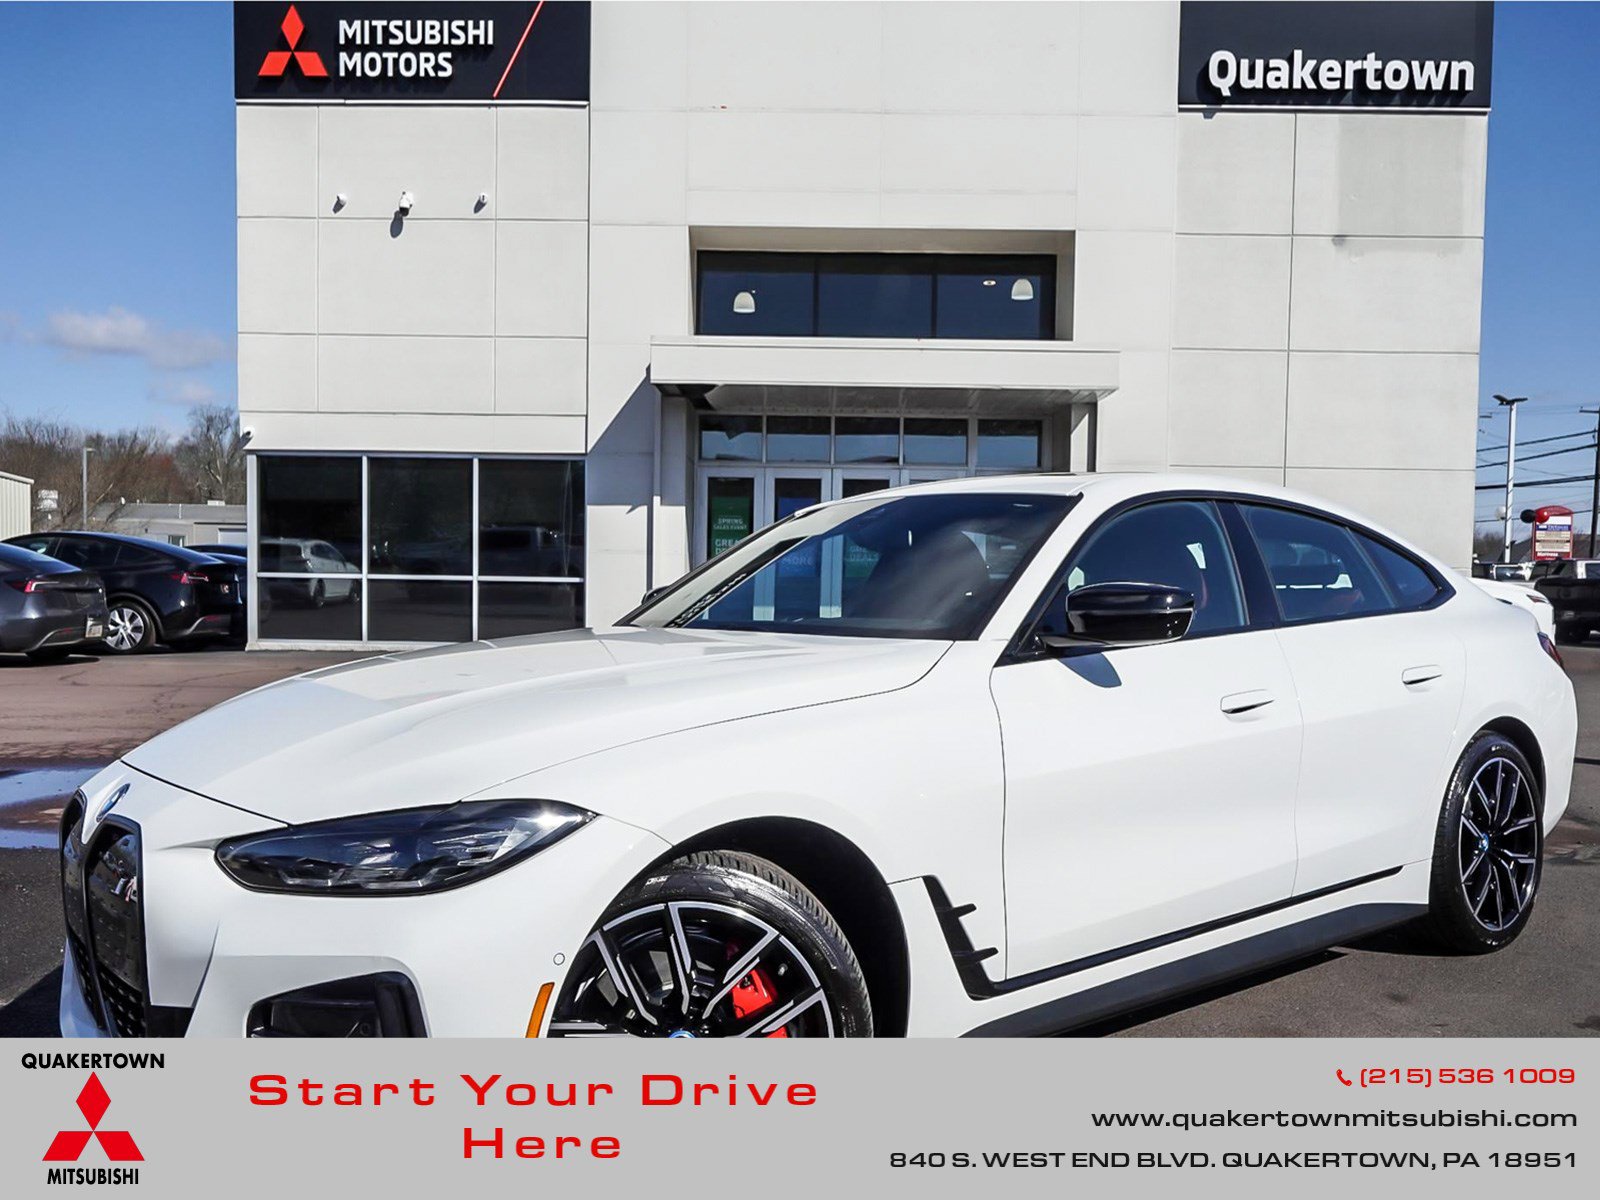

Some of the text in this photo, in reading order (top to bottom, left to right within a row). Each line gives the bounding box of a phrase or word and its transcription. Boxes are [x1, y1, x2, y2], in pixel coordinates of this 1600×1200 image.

[338, 19, 494, 46] MITSUBISHI
[338, 51, 454, 78] MOTORS
[1208, 49, 1475, 97] Quakertown
